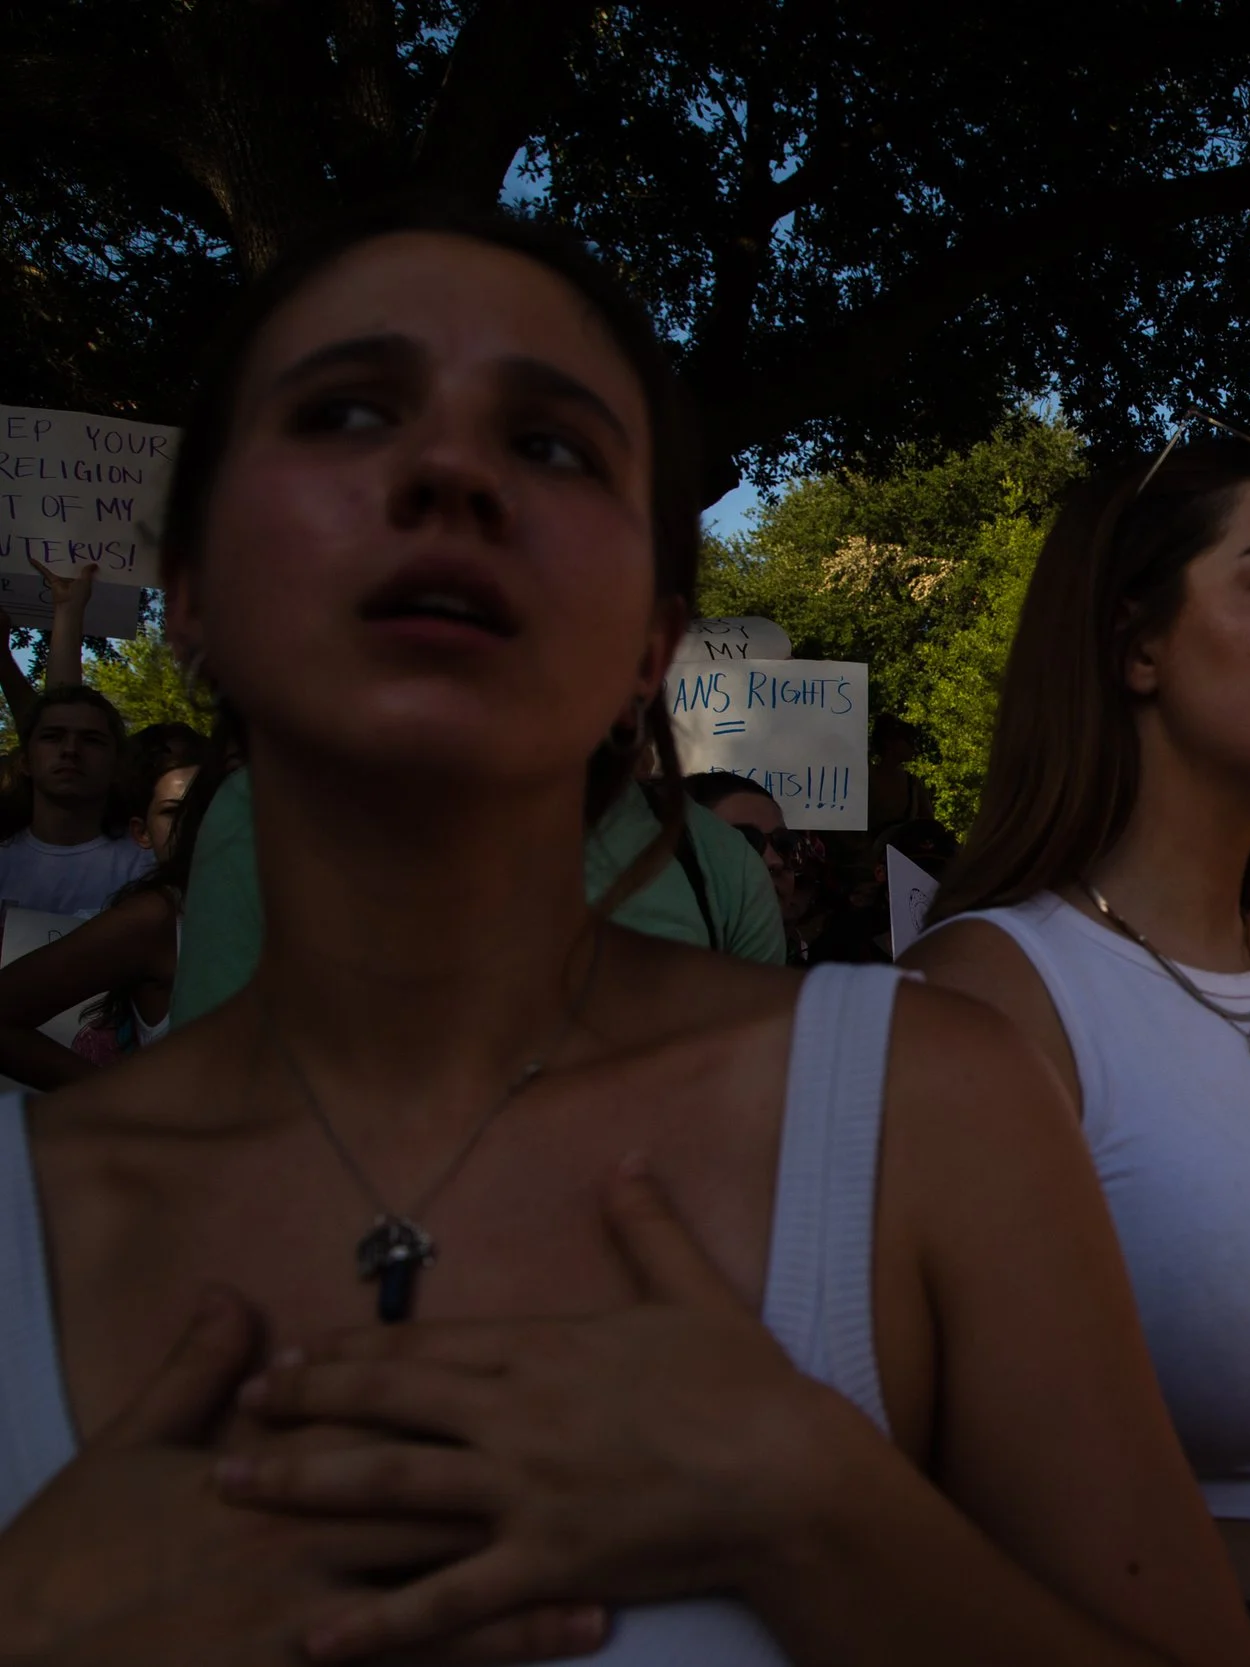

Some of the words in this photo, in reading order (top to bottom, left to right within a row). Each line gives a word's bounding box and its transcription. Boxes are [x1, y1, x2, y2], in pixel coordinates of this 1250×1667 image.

[7, 417, 52, 442] EP
[86, 425, 173, 461] YOUR
[41, 494, 84, 523] OF
[96, 497, 135, 522] MY
[704, 640, 748, 660] MY
[664, 673, 730, 715] ANS
